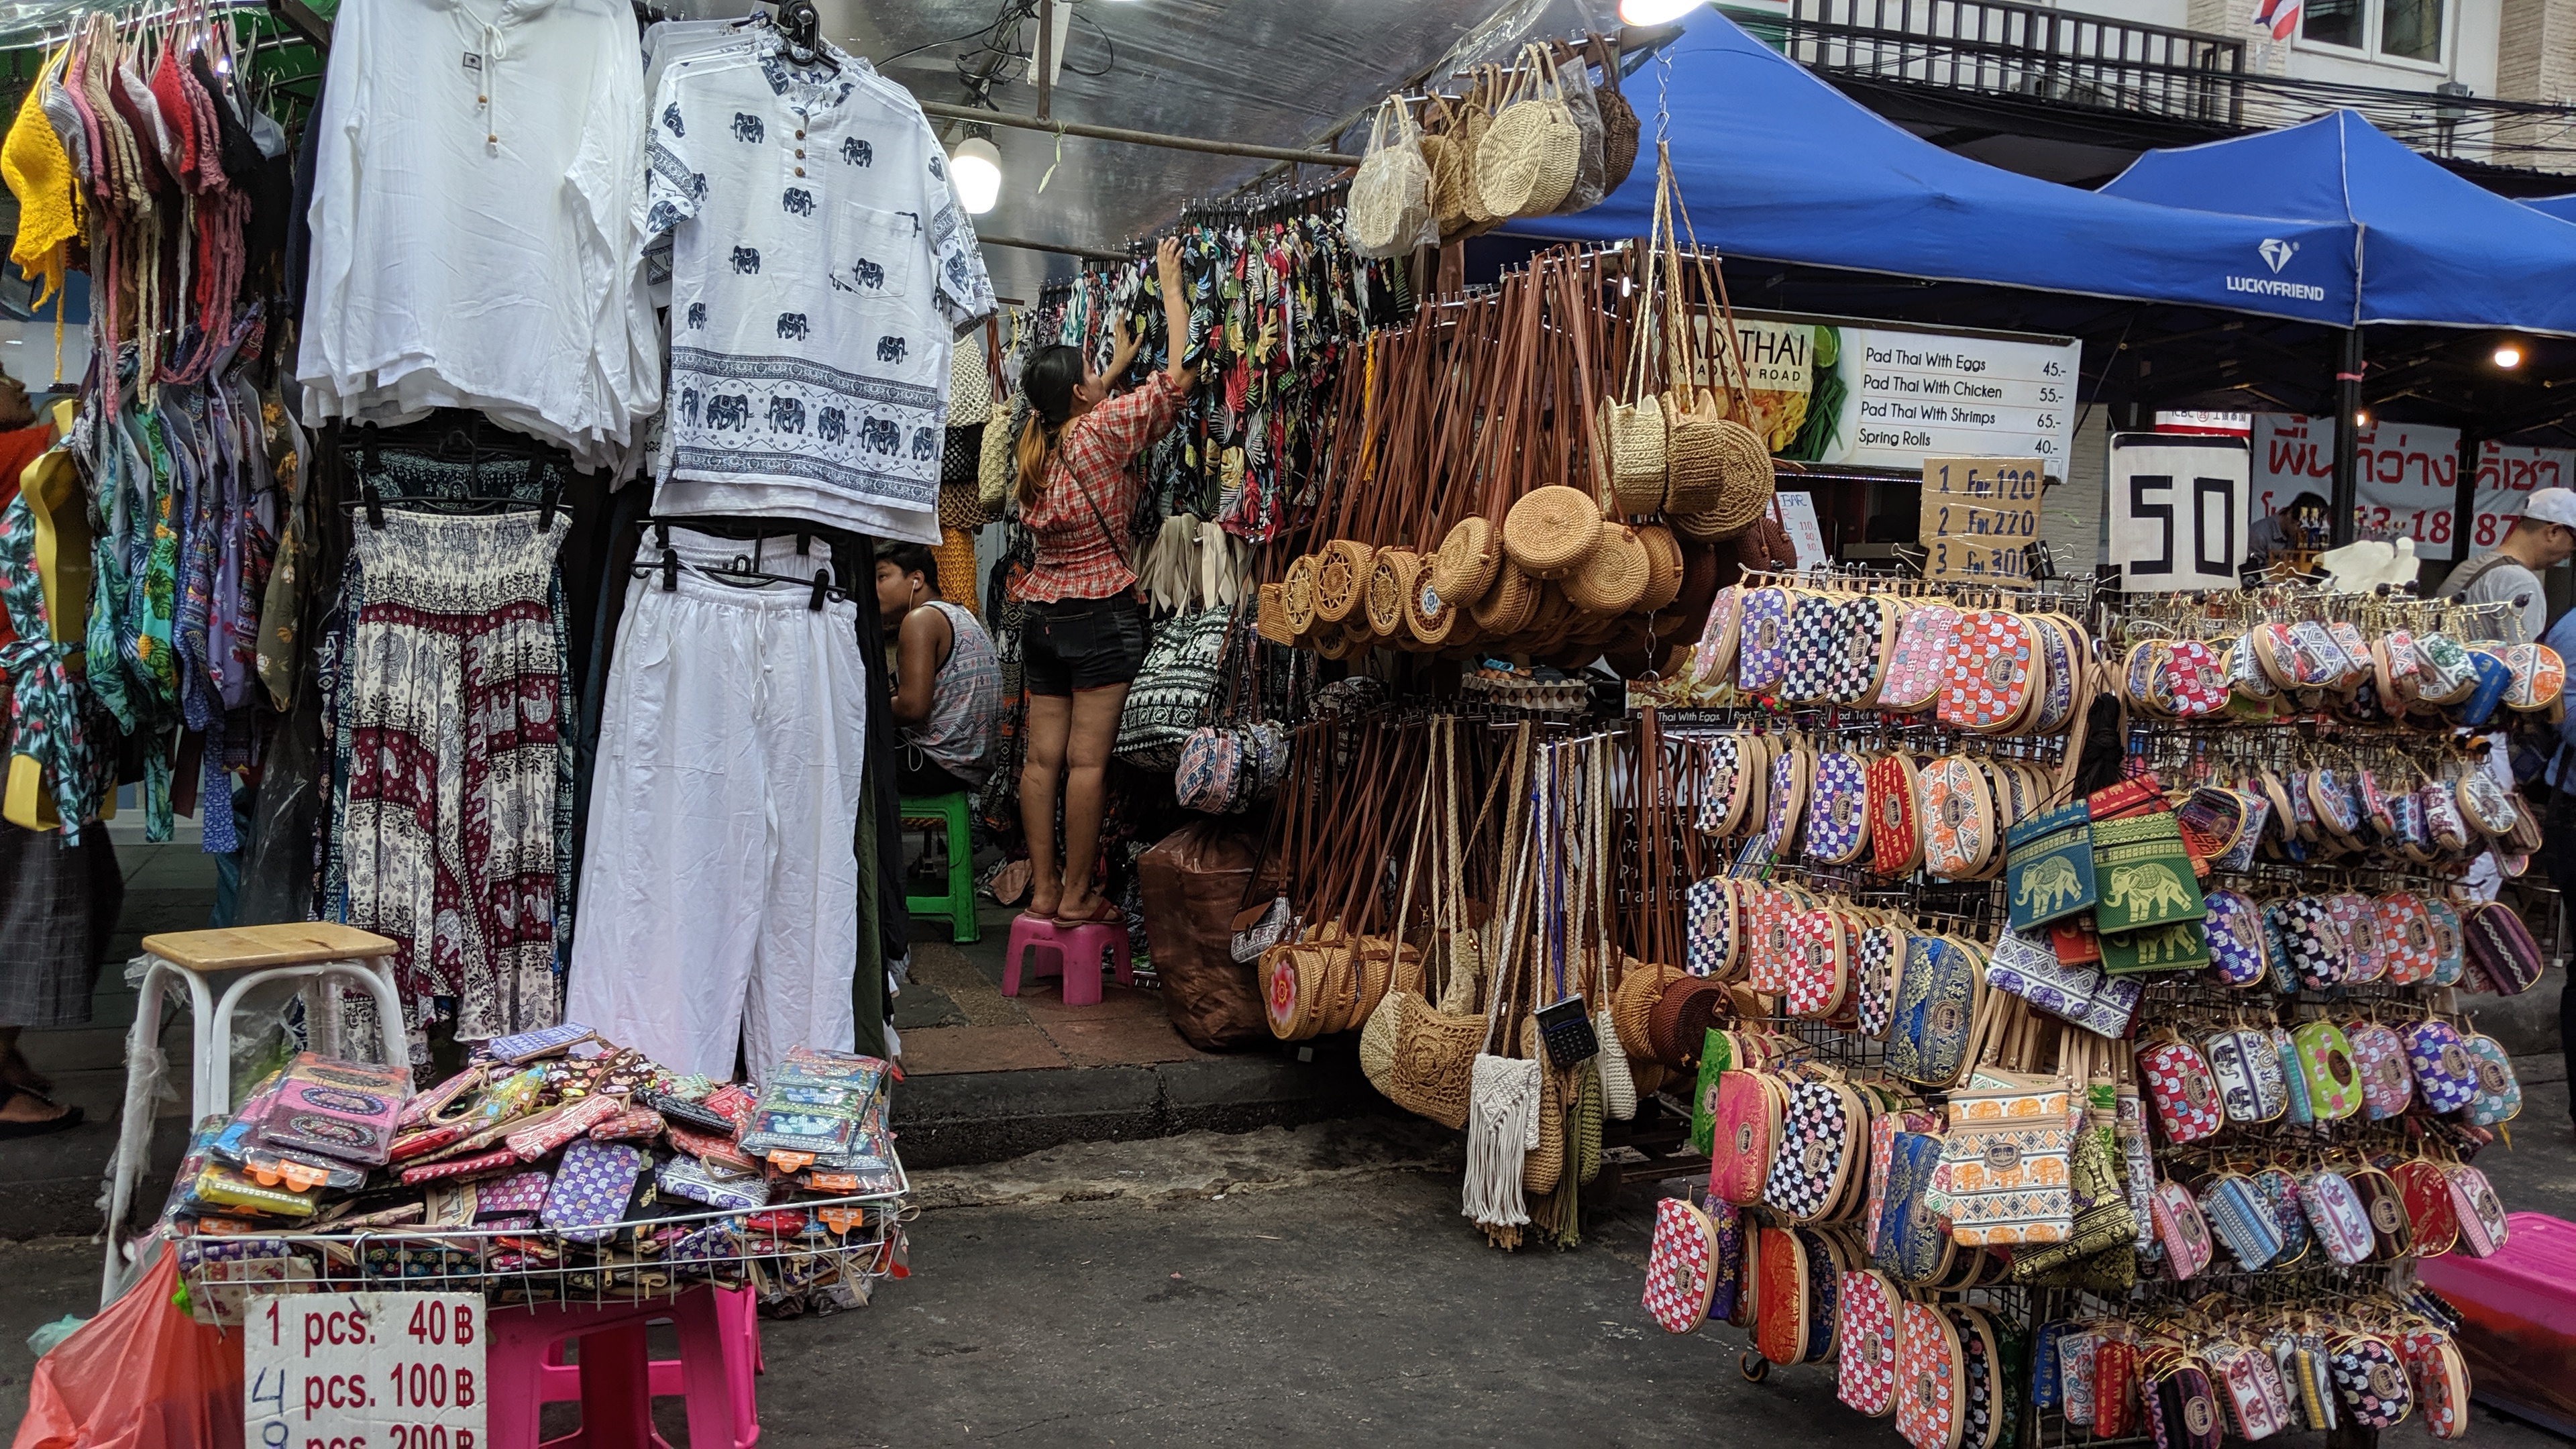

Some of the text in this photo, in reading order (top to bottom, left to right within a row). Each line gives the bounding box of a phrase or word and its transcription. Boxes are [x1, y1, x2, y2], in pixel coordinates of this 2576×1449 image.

[2226, 275, 2324, 301] LUCKYFRIEND
[1738, 329, 1805, 366] THAI
[1866, 347, 2067, 377] Pad Thai With Eggs 45.-
[1759, 369, 1801, 381] ROAD
[1863, 374, 2064, 402] Pad Thai With Chicken 55.-
[1860, 401, 2061, 429] Pad Thai With Shrimps 65.-
[1858, 428, 2059, 454] Spring Rolls 40.-
[1939, 464, 1949, 494] 1
[1996, 469, 2035, 500] 120
[1937, 506, 1949, 537] 2
[1994, 509, 2035, 536] 220
[2130, 475, 2234, 578] 50
[1935, 543, 1947, 574] 3
[1658, 712, 1676, 722] Thai
[1678, 713, 1697, 722] With
[266, 1300, 278, 1346] 1
[305, 1311, 375, 1358] pcs.
[408, 1300, 446, 1345] 40
[252, 1366, 285, 1417] 4
[305, 1375, 375, 1421] pcs.
[390, 1363, 446, 1408] 100
